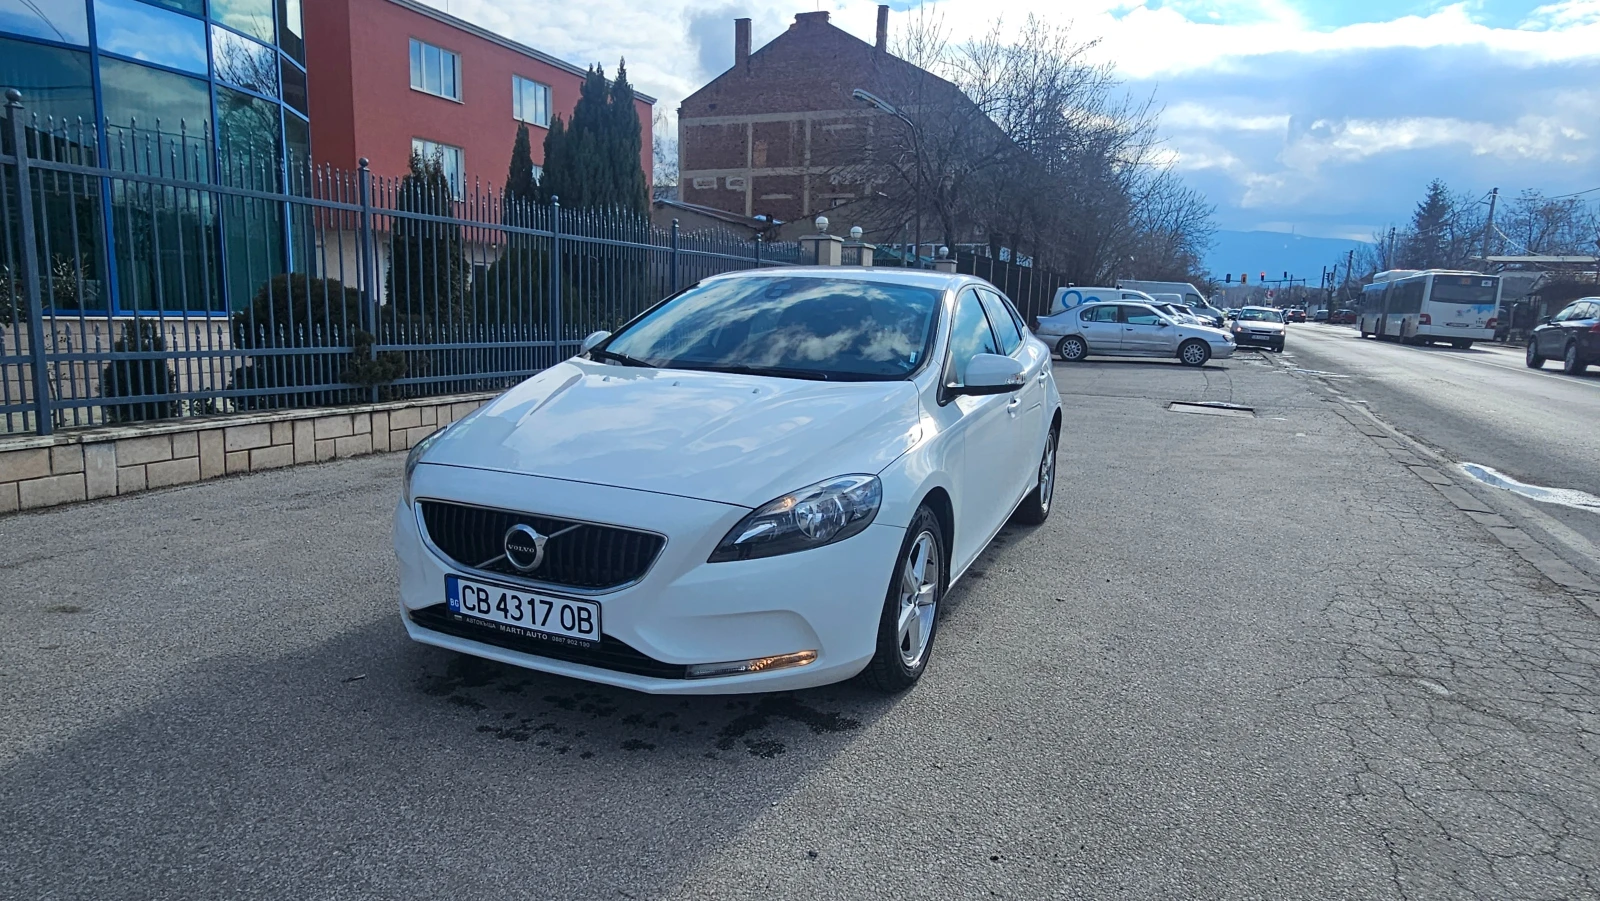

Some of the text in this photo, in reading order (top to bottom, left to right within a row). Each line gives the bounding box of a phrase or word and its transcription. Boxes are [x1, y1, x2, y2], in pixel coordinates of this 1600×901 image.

[508, 544, 535, 553] VOLVO
[450, 598, 459, 607] BG
[462, 585, 594, 634] CB 4317 OB
[500, 625, 524, 635] MARTI
[526, 631, 548, 640] AUTO
